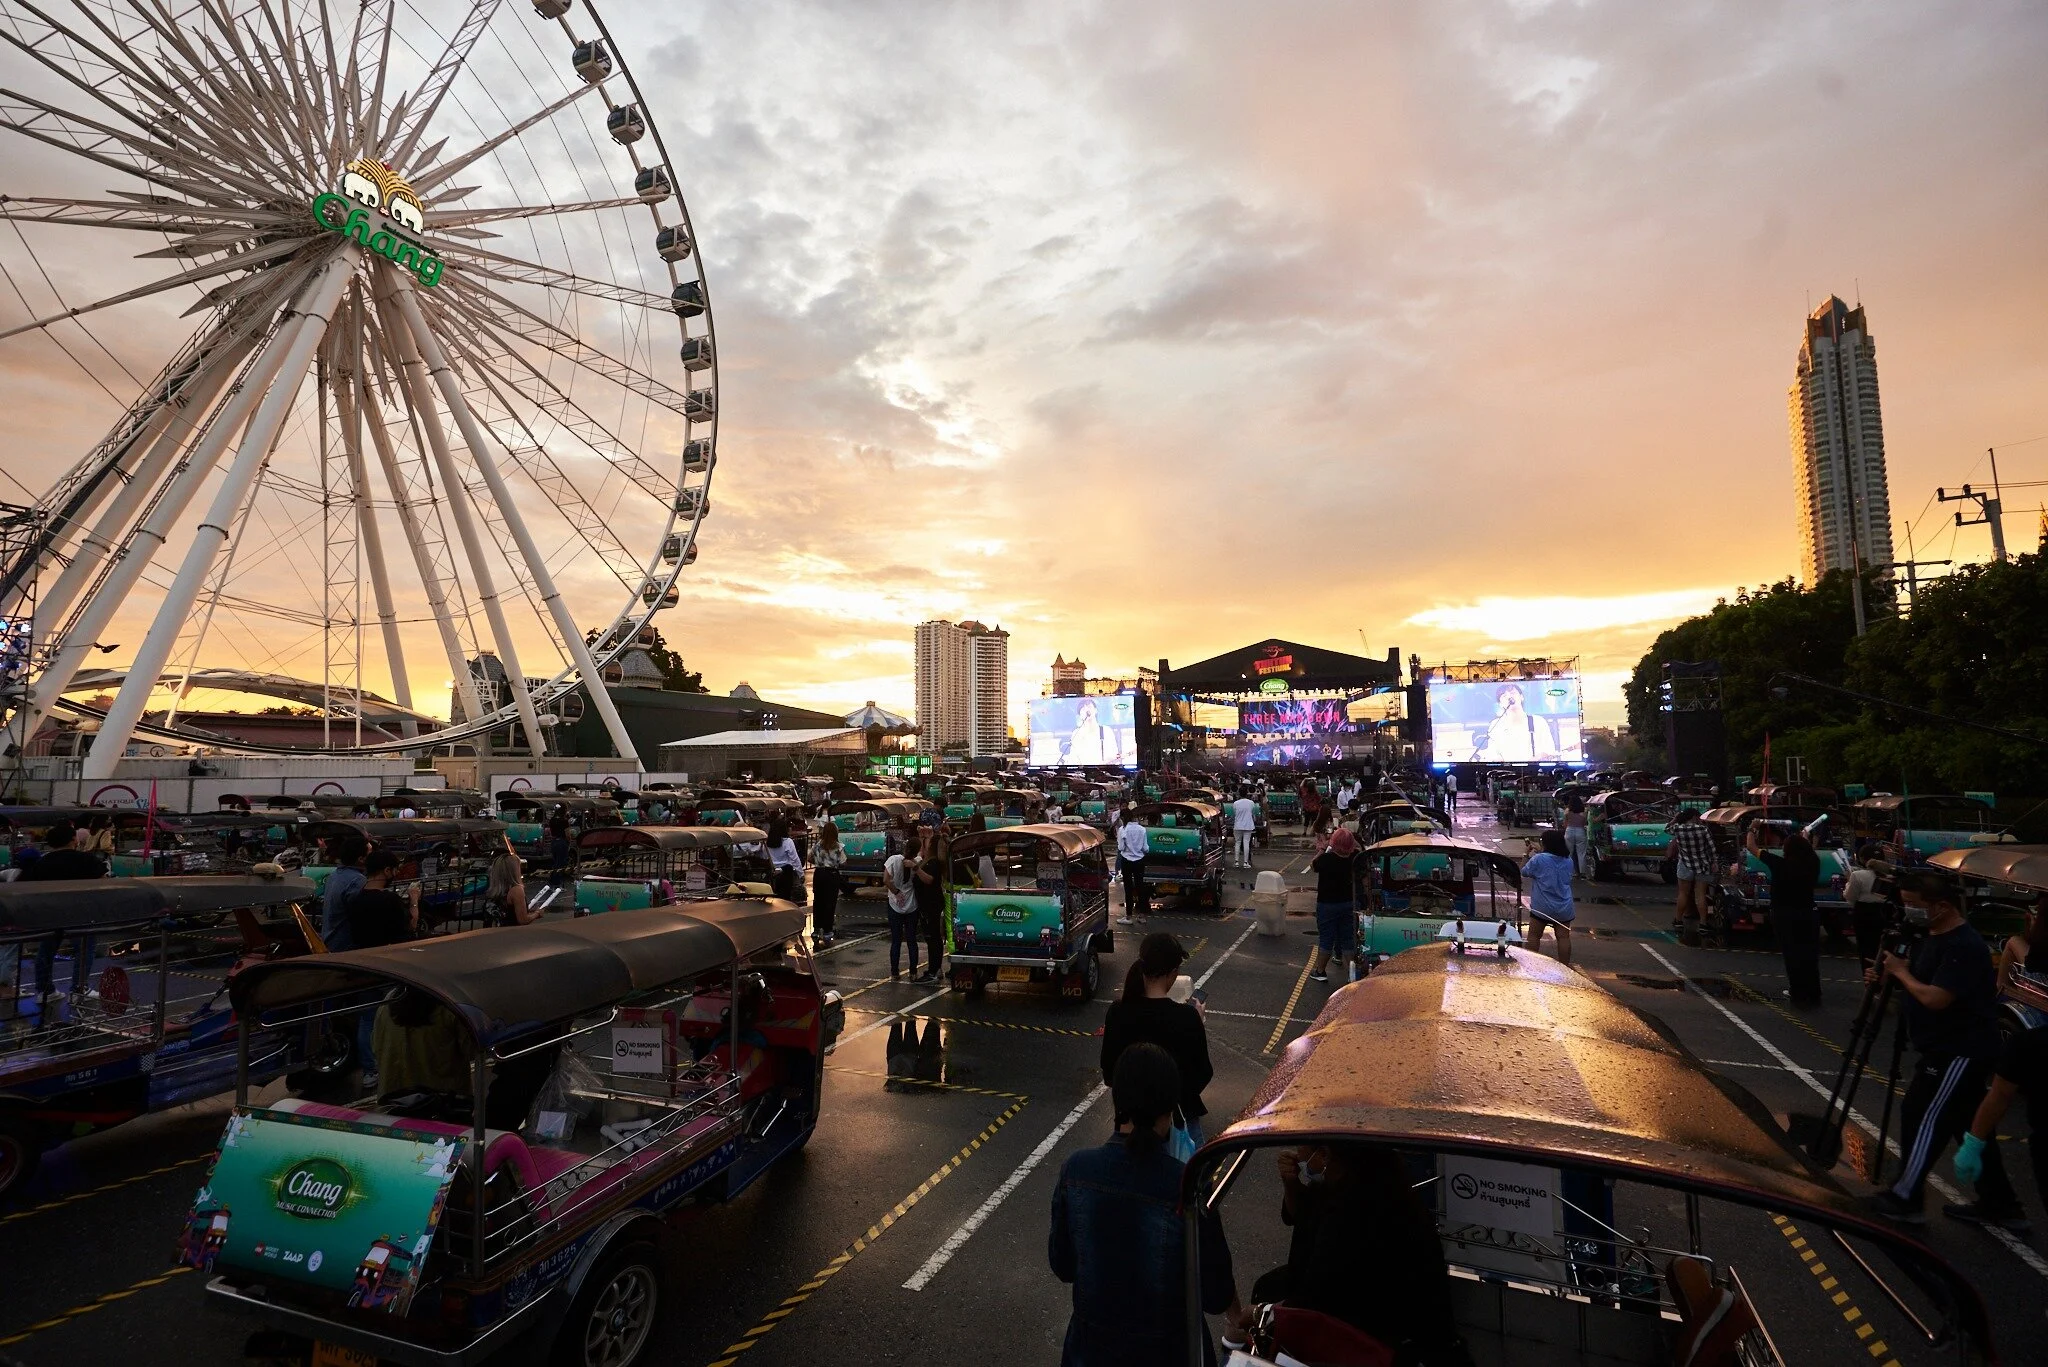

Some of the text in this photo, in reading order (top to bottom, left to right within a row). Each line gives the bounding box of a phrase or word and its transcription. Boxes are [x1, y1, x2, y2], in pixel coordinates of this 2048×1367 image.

[312, 186, 445, 287] Chang
[1259, 663, 1292, 675] FESTIVAL
[1263, 681, 1286, 690] Chang
[1243, 713, 1276, 725] THREE
[136, 798, 149, 809] Sk
[595, 889, 632, 899] THAILAND
[996, 908, 1021, 919] Chang
[1401, 929, 1441, 942] THAIL
[288, 1170, 343, 1206] Chang
[1480, 1180, 1547, 1198] NO SMOKING
[1480, 1191, 1531, 1209] ห้ามสูบบุหรี่
[276, 1200, 337, 1219] MUSIC CONNECTION
[283, 1250, 304, 1263] ZAAP
